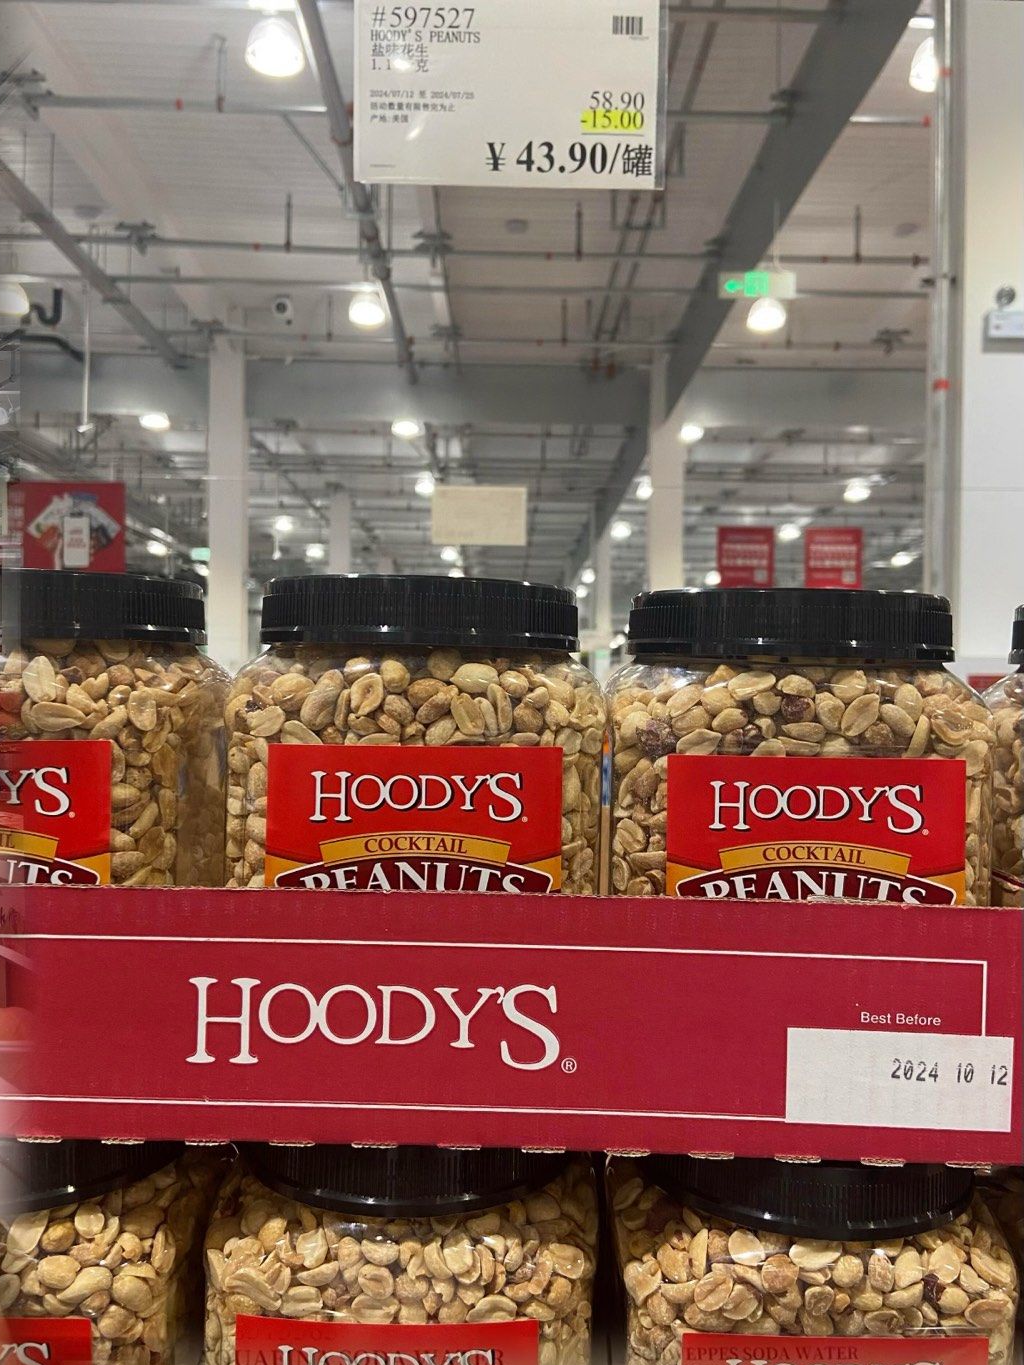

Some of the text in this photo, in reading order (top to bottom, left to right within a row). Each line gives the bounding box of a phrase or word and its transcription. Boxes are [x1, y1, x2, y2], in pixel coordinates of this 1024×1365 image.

[371, 5, 475, 29] #597527
[429, 31, 481, 43] PEANUTS
[371, 58, 429, 73] 1.1克
[588, 91, 645, 111] 58.90
[580, 110, 645, 129] -15.00
[309, 770, 523, 823] HOODY'S
[707, 780, 924, 835] HOODY'S
[364, 833, 468, 855] COCKTAIL
[761, 844, 866, 866] COCKTAIL
[300, 859, 526, 893] PEANUTS
[700, 870, 927, 904] PEANUTS
[185, 976, 560, 1070] HOODY'S
[860, 1011, 942, 1026] Best Before
[891, 1057, 1009, 1086] 2024 10 12
[745, 1346, 858, 1361] SODA WATER
